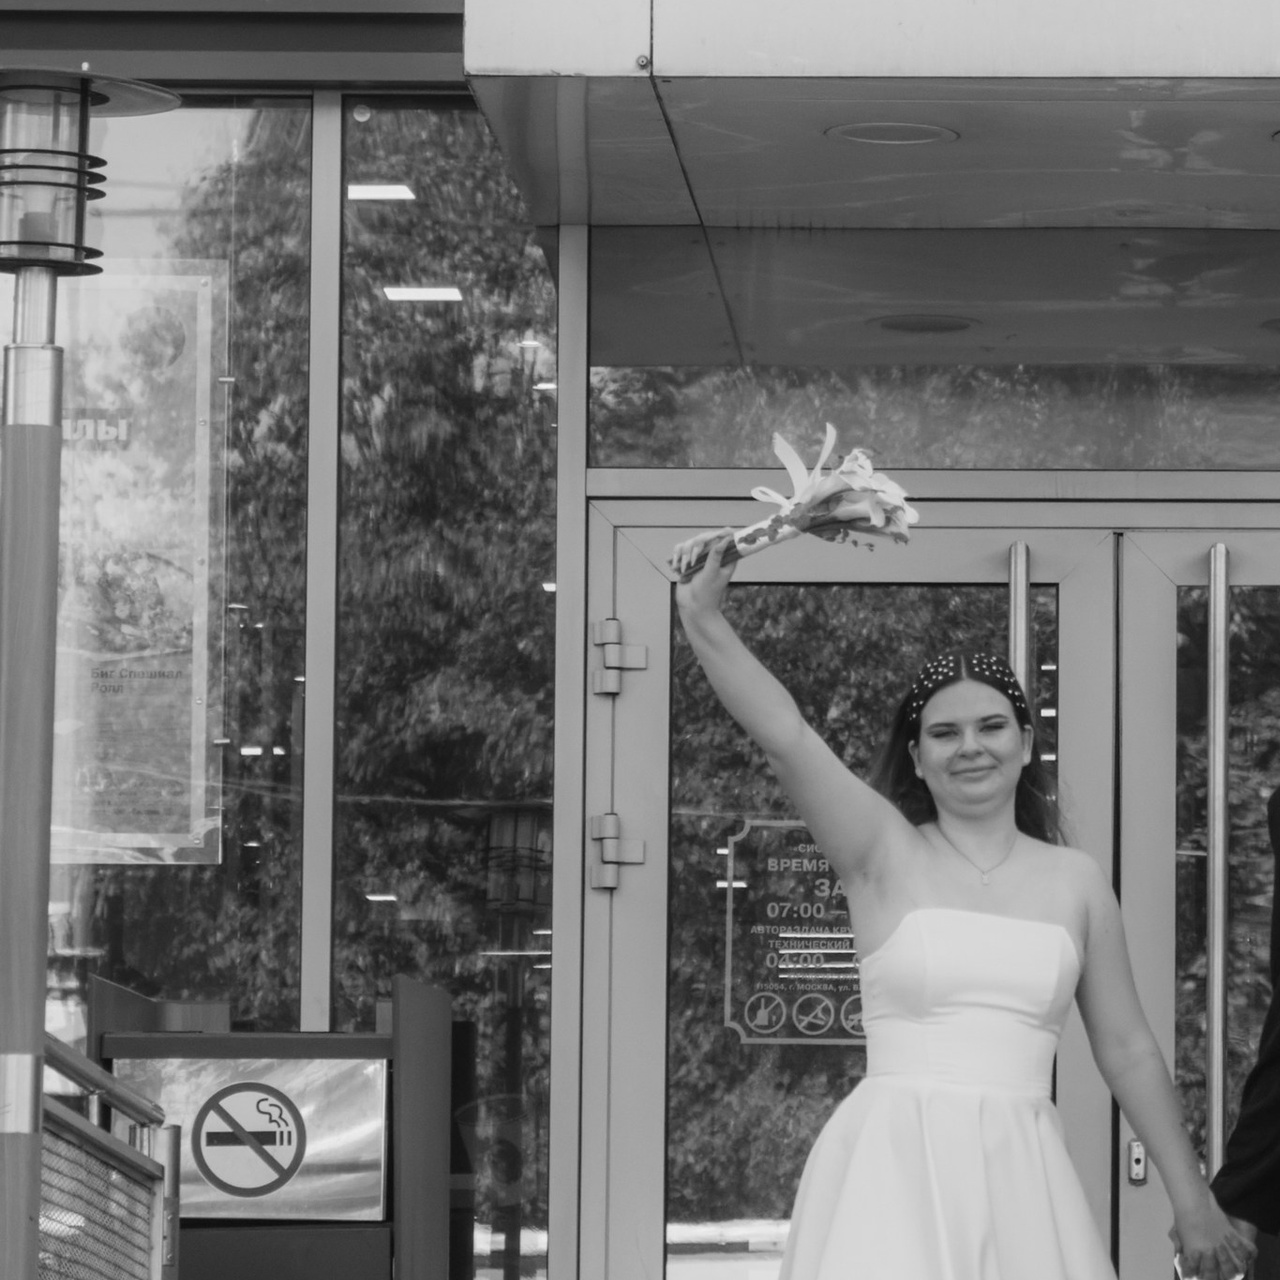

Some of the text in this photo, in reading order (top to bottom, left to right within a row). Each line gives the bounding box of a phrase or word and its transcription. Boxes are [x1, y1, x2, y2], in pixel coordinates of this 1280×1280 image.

[767, 858, 829, 872] ВРЕМЯ
[814, 878, 848, 897] ЗА
[766, 902, 825, 918] 07:00
[750, 926, 830, 935] АВТОРАЗДАЧА
[768, 939, 850, 950] ТЕХНИЧЕСКИЙ
[765, 952, 825, 969] 04:00
